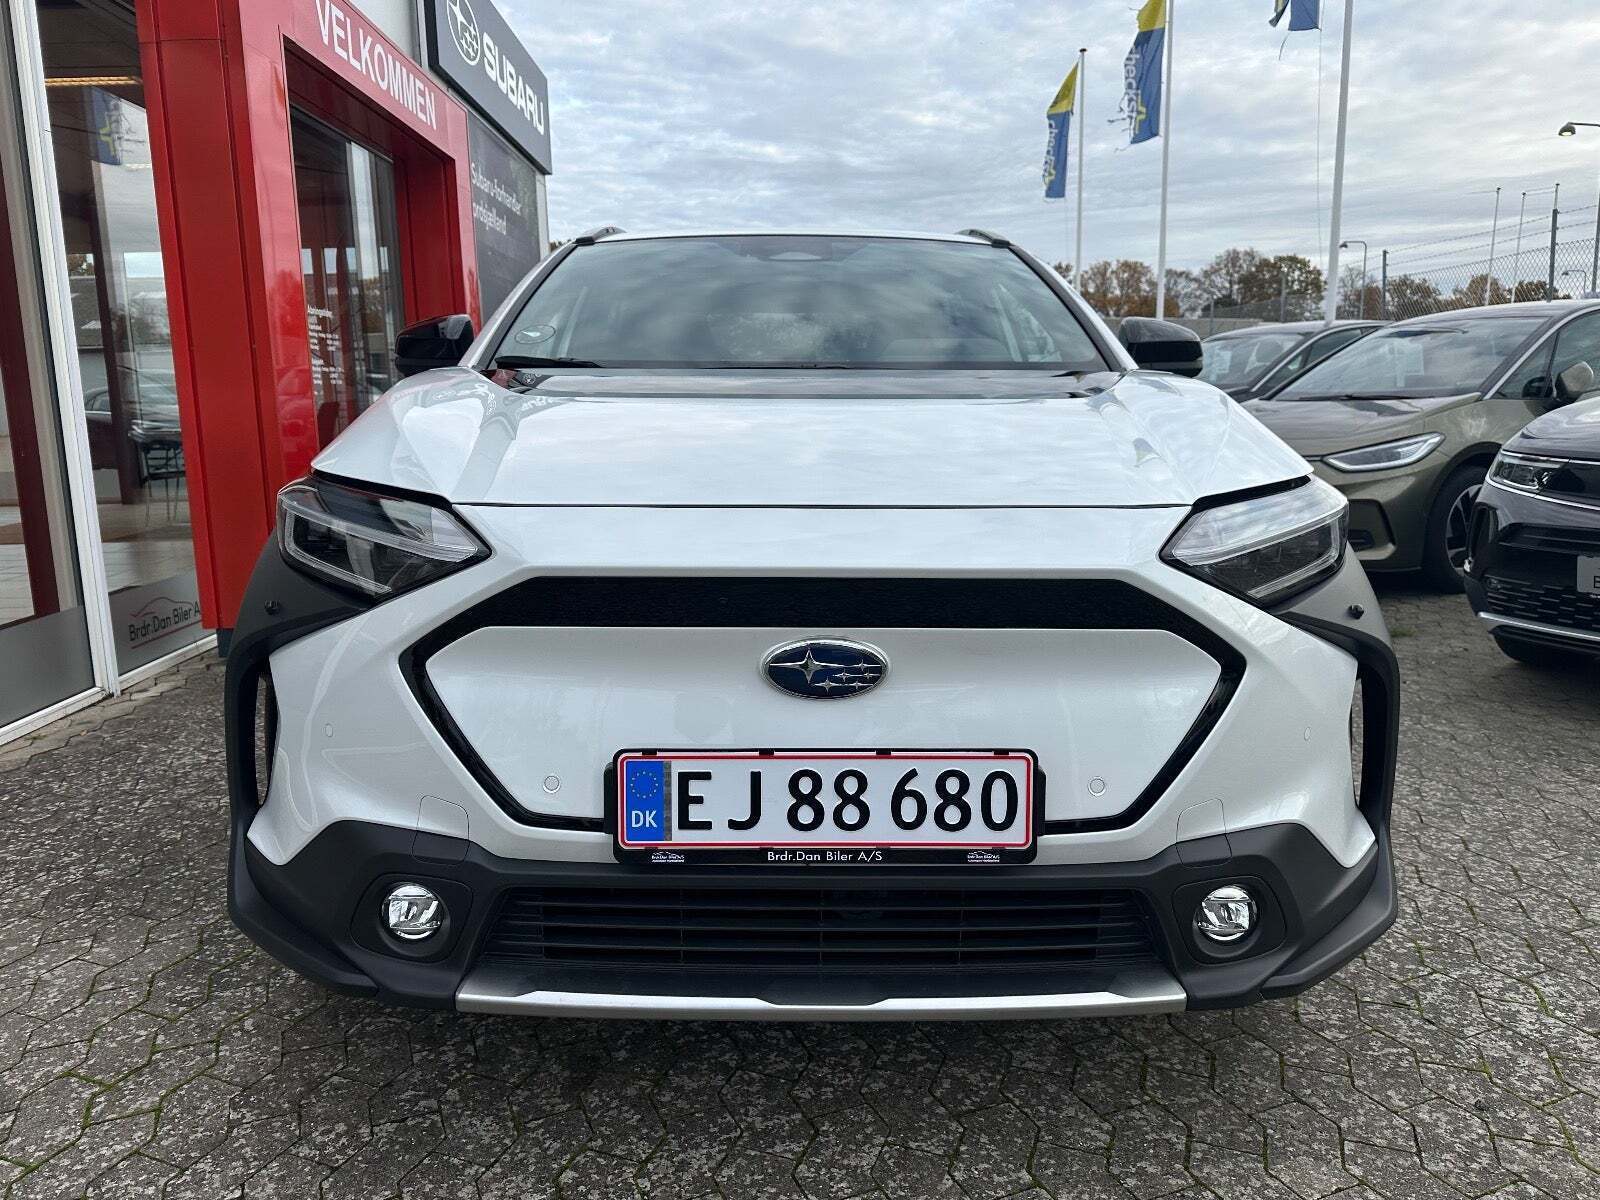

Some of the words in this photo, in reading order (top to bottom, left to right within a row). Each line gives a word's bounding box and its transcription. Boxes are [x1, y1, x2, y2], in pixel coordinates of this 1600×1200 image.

[315, 0, 437, 131] VELKOMMEN
[483, 32, 545, 135] SUBARU
[173, 606, 192, 625] Biler
[631, 810, 658, 828] DK
[677, 771, 762, 830] EJ
[786, 768, 871, 832] 88
[890, 768, 1018, 832] 680
[767, 851, 821, 861] Brdr.Dan
[825, 851, 854, 861] Biler
[858, 851, 883, 862] A/S
